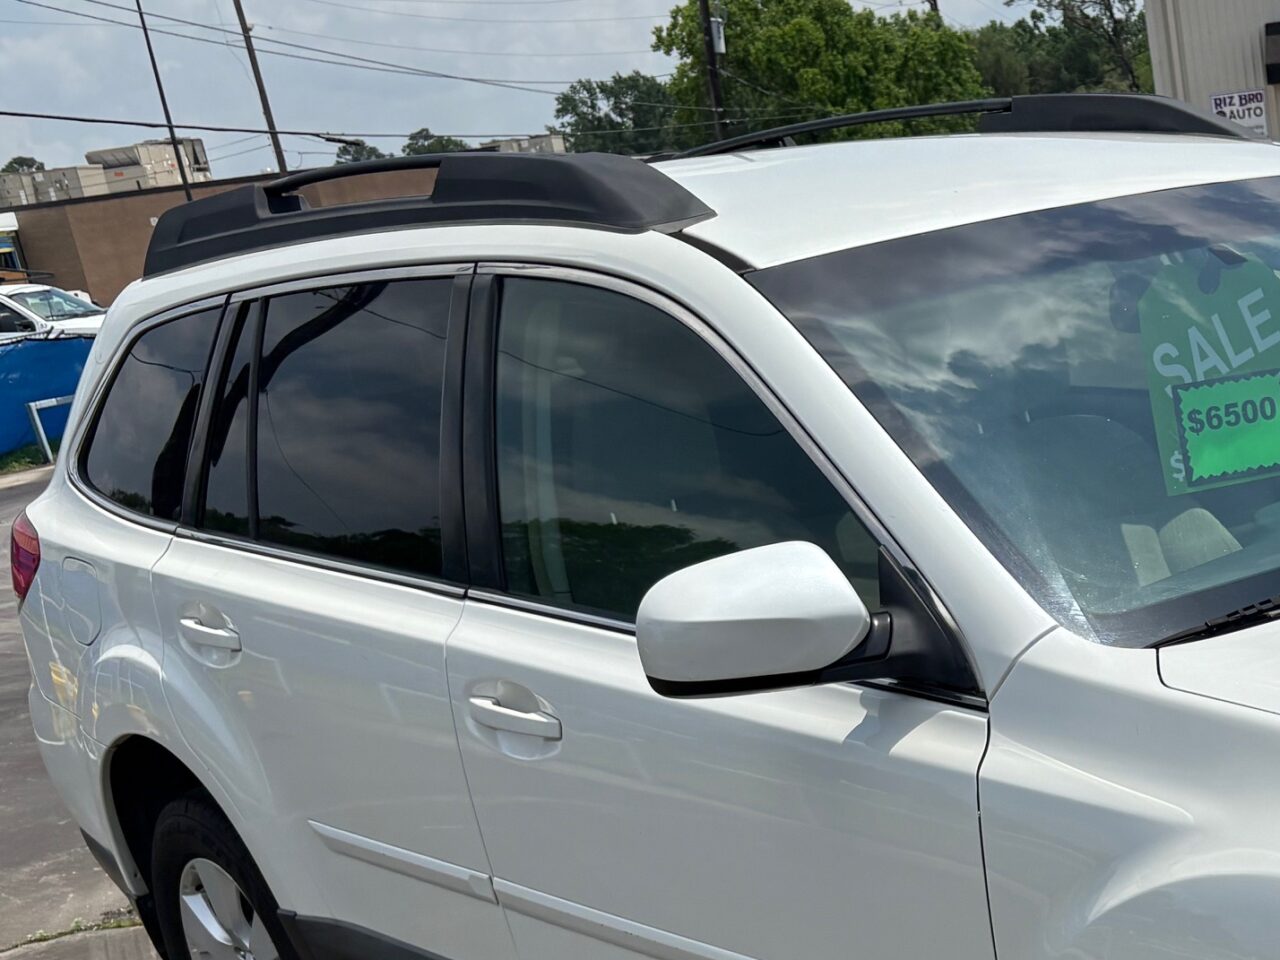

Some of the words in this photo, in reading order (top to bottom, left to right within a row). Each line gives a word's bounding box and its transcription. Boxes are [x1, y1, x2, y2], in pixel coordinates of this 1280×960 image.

[1213, 96, 1236, 110] RIZ
[1237, 92, 1263, 107] BRO
[1229, 106, 1263, 120] AUTO
[1187, 396, 1277, 436] $6500
